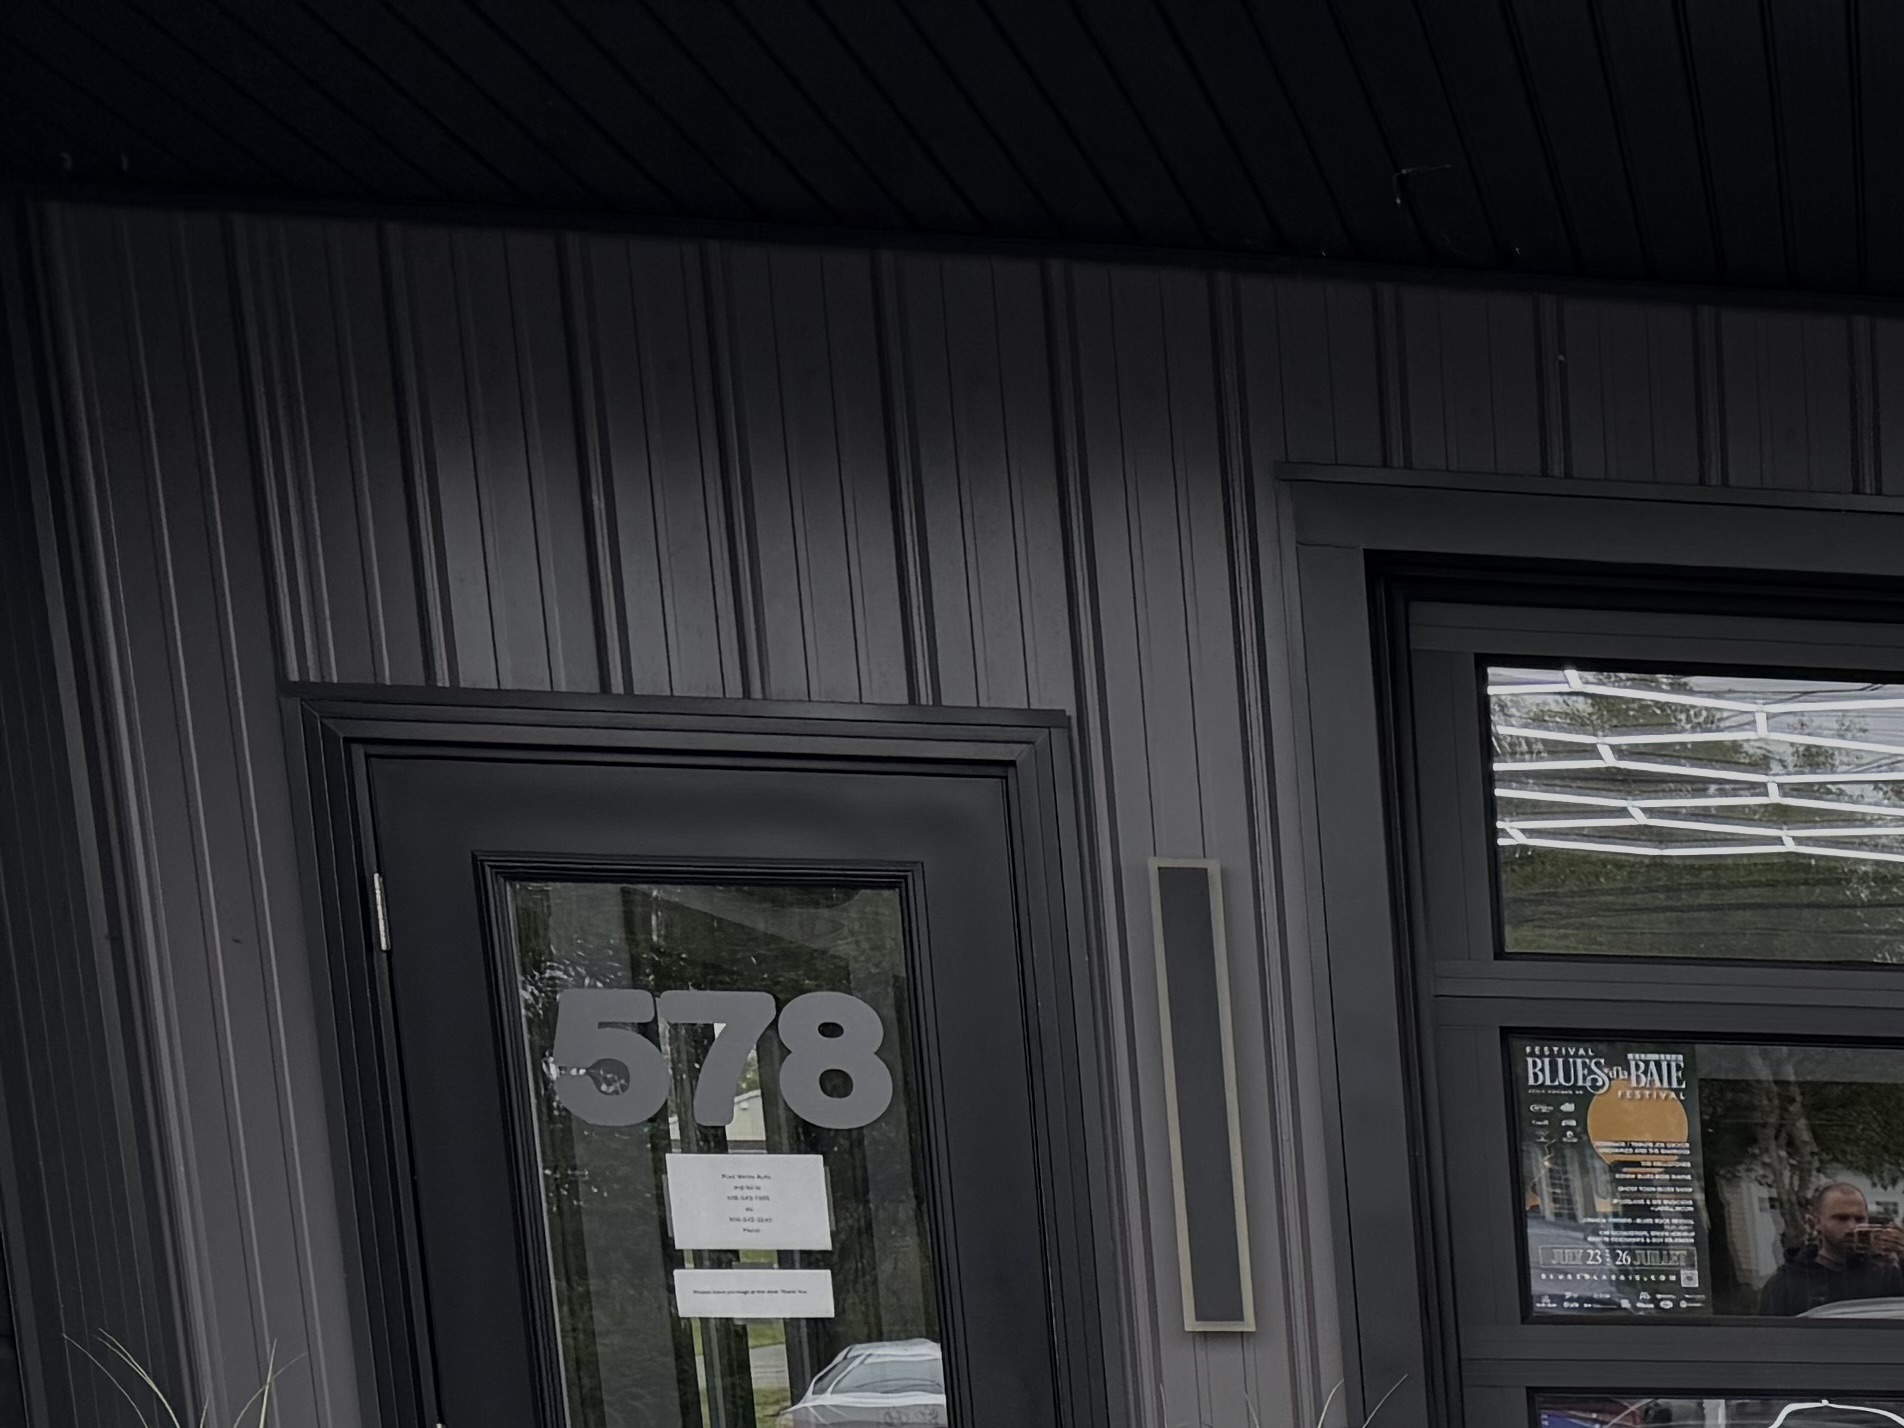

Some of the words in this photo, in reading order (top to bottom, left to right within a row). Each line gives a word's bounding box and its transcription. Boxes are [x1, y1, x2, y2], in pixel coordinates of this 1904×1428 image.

[553, 988, 893, 1130] 578
[1525, 1046, 1595, 1056] FESTIVAL
[1526, 1057, 1610, 1094] BLUES
[1629, 1060, 1686, 1089] BAIE
[1617, 1090, 1686, 1100] FESTIVAL
[1551, 1249, 1582, 1265] JULY
[1587, 1250, 1601, 1265] 23
[1615, 1250, 1631, 1265] 26
